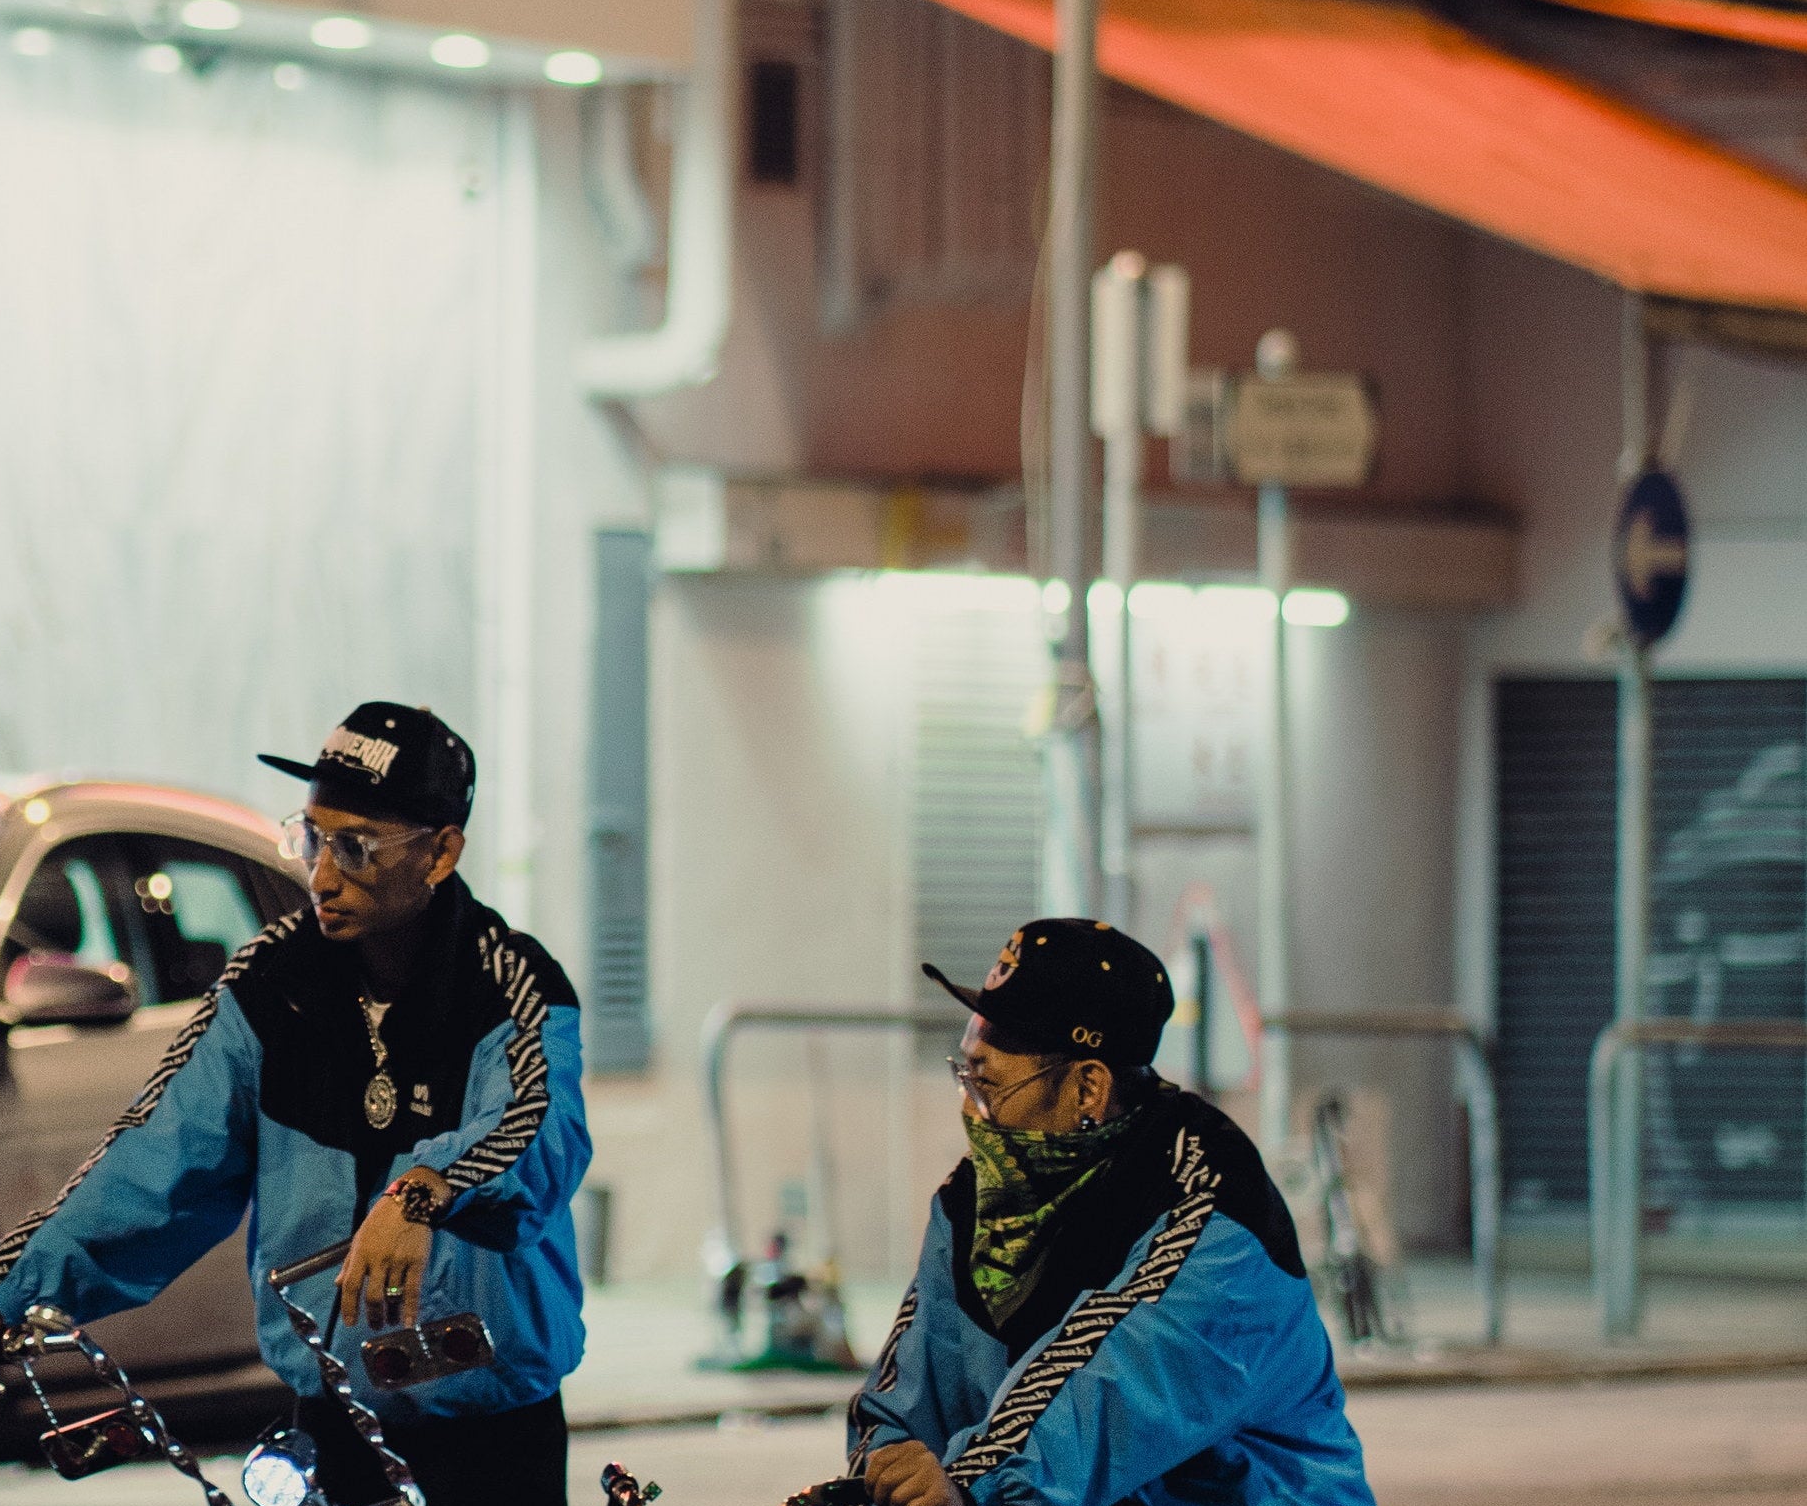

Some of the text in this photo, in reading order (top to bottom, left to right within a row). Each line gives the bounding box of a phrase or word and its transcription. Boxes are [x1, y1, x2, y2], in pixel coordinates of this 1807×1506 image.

[1072, 1026, 1103, 1048] OG
[1137, 1248, 1186, 1276] yasaki
[1065, 1316, 1115, 1336] yasaki
[1043, 1345, 1093, 1361] yasaki
[1004, 1390, 1053, 1408] yasaki
